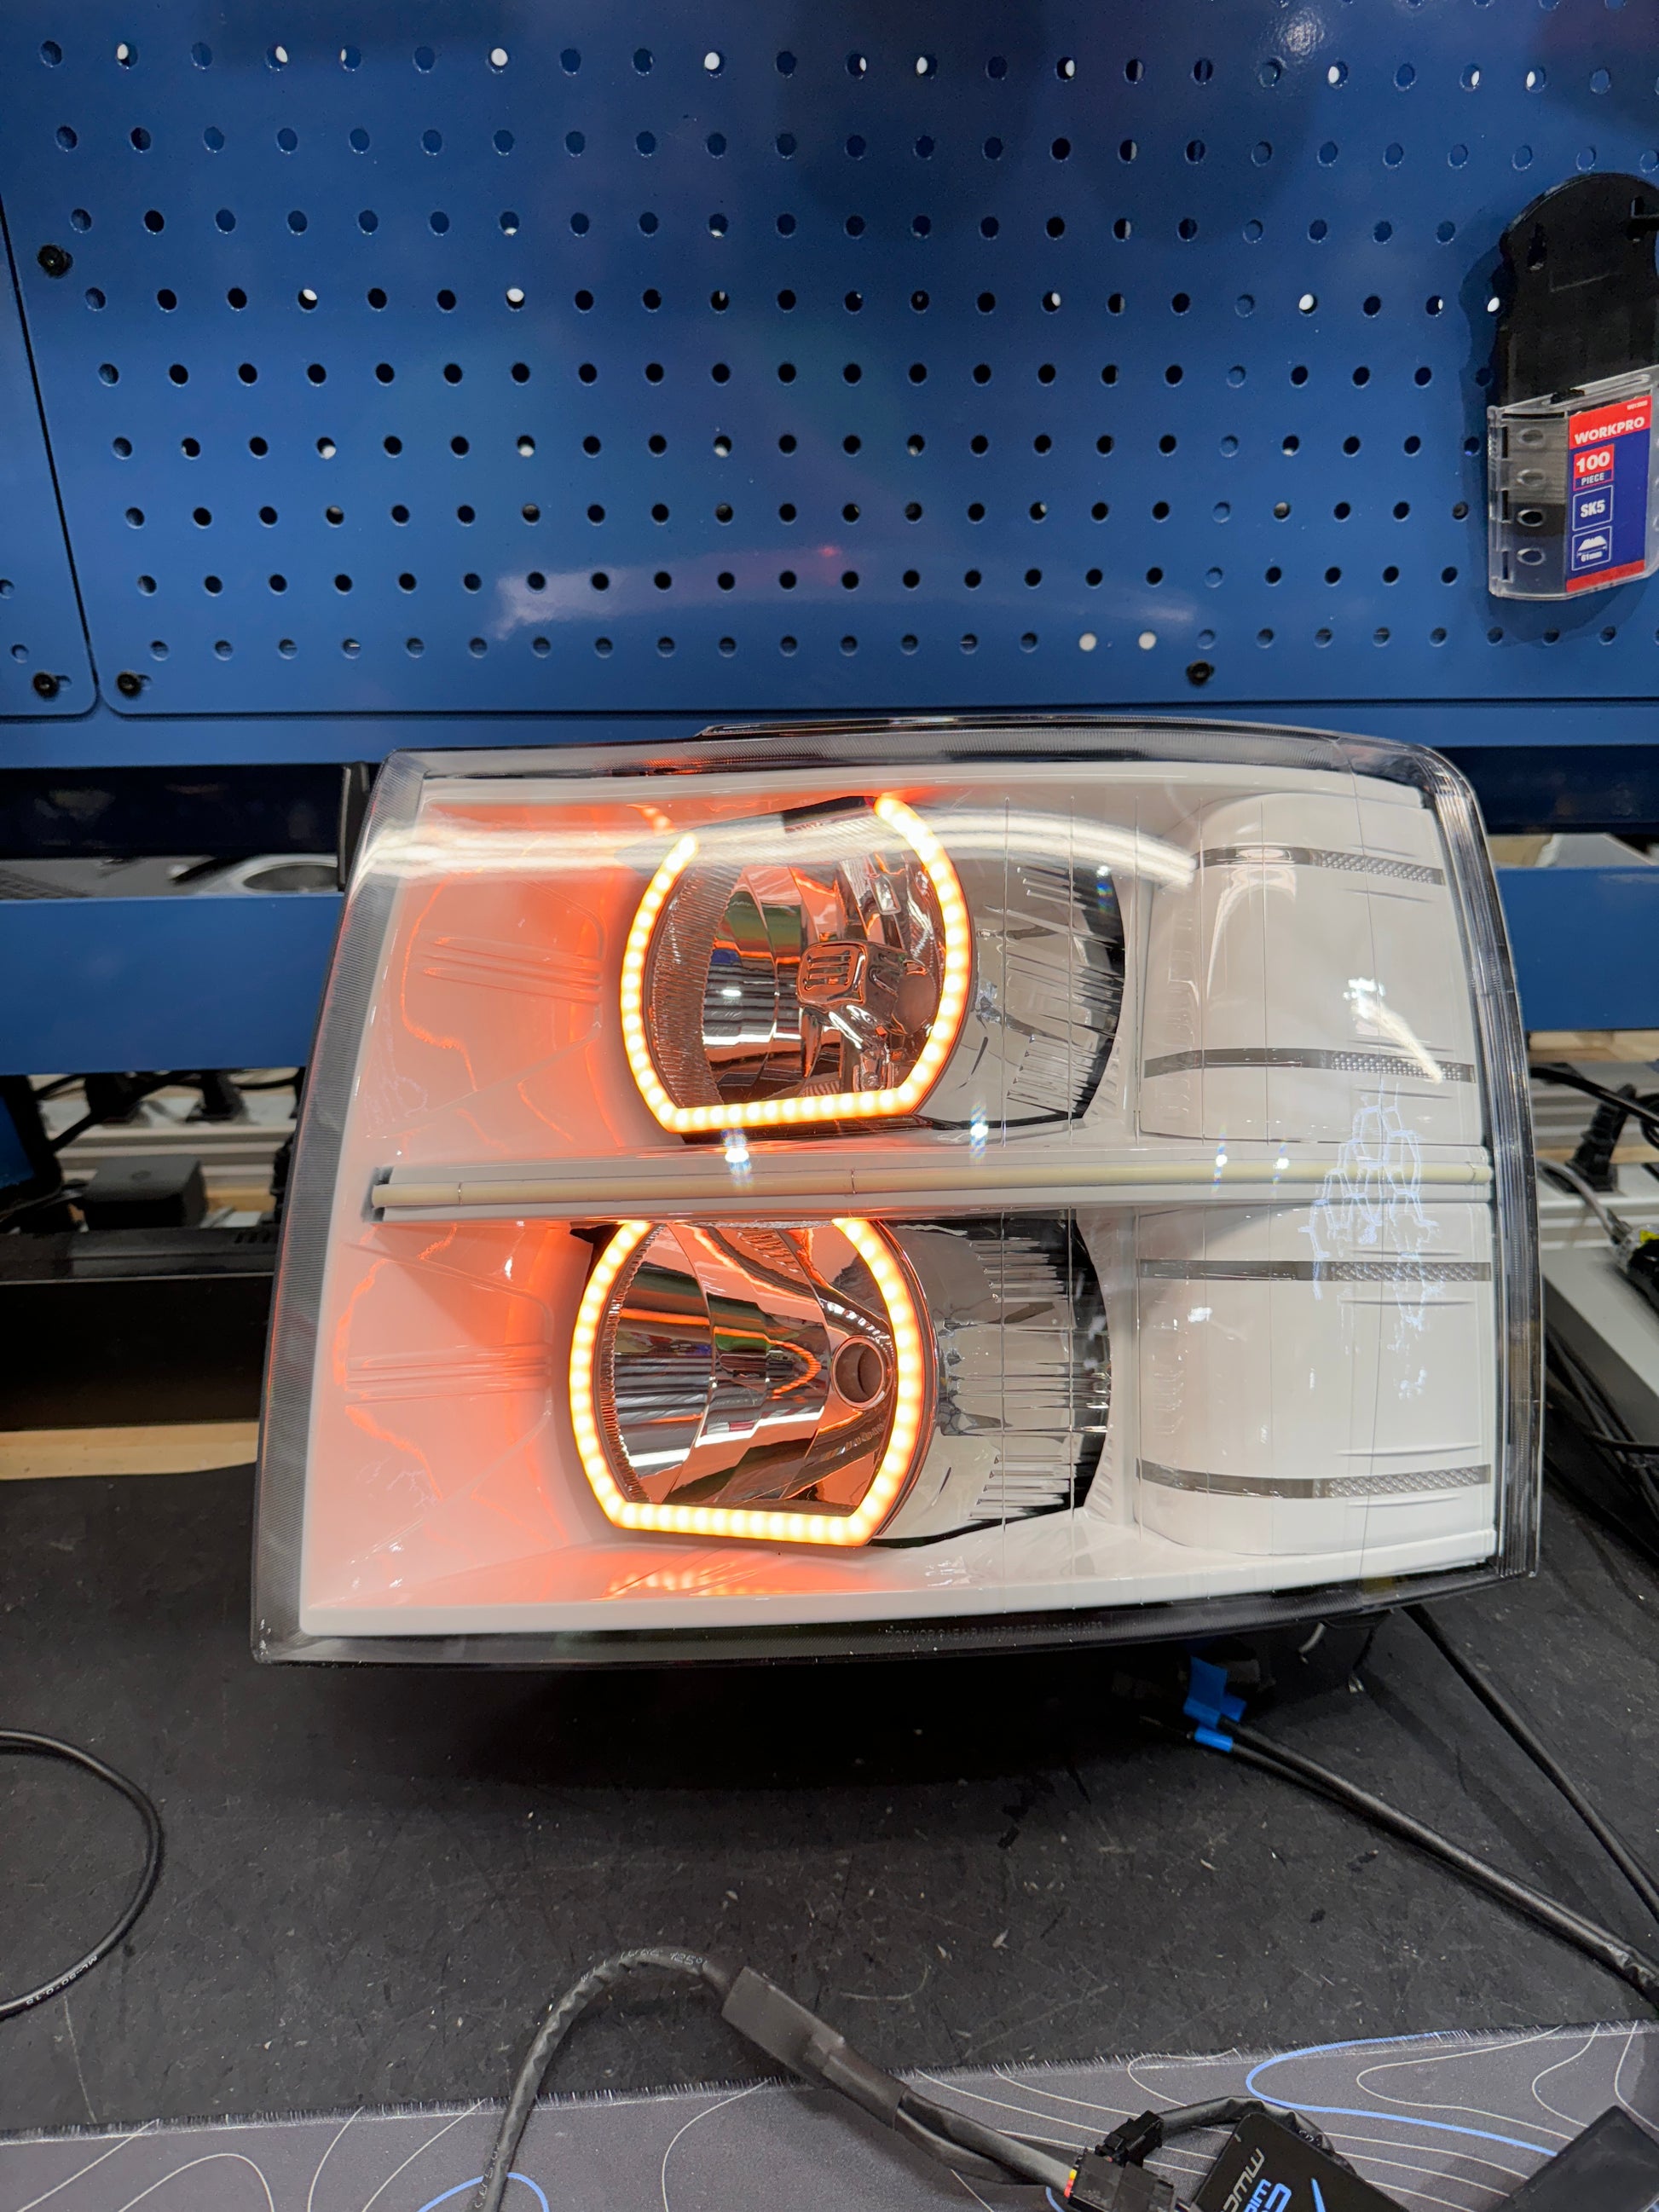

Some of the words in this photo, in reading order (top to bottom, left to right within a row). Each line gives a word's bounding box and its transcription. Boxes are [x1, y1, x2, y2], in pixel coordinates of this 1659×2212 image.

[1574, 417, 1645, 445] WORKPRO
[1576, 452, 1610, 473] 100
[1581, 472, 1605, 486] PIECE
[1580, 500, 1605, 518] SK5
